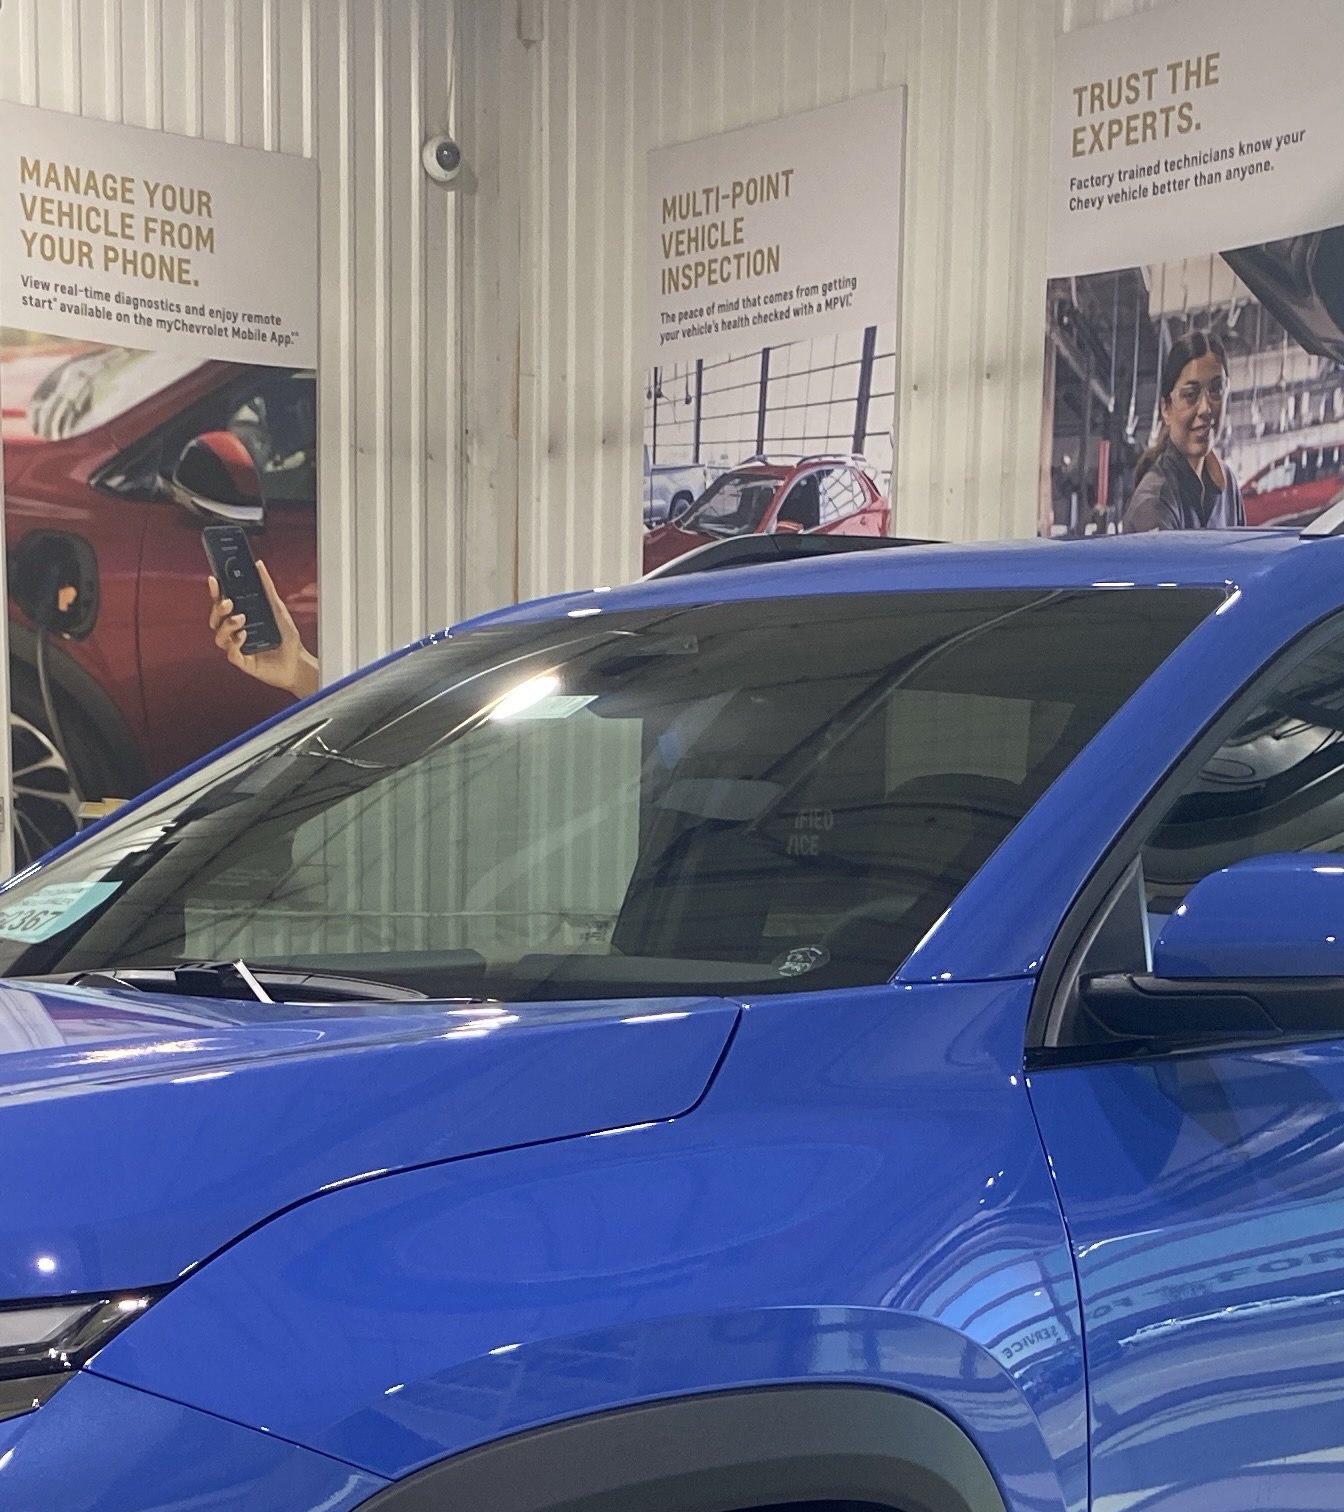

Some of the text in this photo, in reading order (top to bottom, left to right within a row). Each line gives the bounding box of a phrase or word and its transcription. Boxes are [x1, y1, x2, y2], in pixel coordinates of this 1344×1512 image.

[1073, 52, 1220, 117] TRUST THE
[1071, 101, 1202, 158] EXPERTS.
[20, 156, 213, 218] MANAGE YOUR
[1069, 129, 1306, 192] Factory trained technicians know your
[1069, 159, 1275, 211] Chevy vehicle better than anyone.
[19, 192, 214, 254] VEHICLE FROM
[662, 168, 794, 224] MULTI-POINT
[21, 229, 199, 287] YOUR PHONE.
[662, 216, 745, 260] VEHICLE
[661, 244, 780, 295] INSPECTION
[21, 275, 282, 326] View real-time diagnostics and enjoy remote
[60, 301, 113, 321] available
[116, 312, 131, 324] on
[133, 312, 153, 328] the
[156, 317, 229, 339] myChevrolet
[231, 327, 267, 343] Mobile
[659, 327, 680, 347] your
[682, 319, 719, 339] vehicle's
[721, 315, 750, 332] health
[752, 308, 791, 327] checked
[793, 303, 814, 318] with
[816, 302, 823, 313] a
[660, 276, 857, 325] The peace of mind that comes from getting
